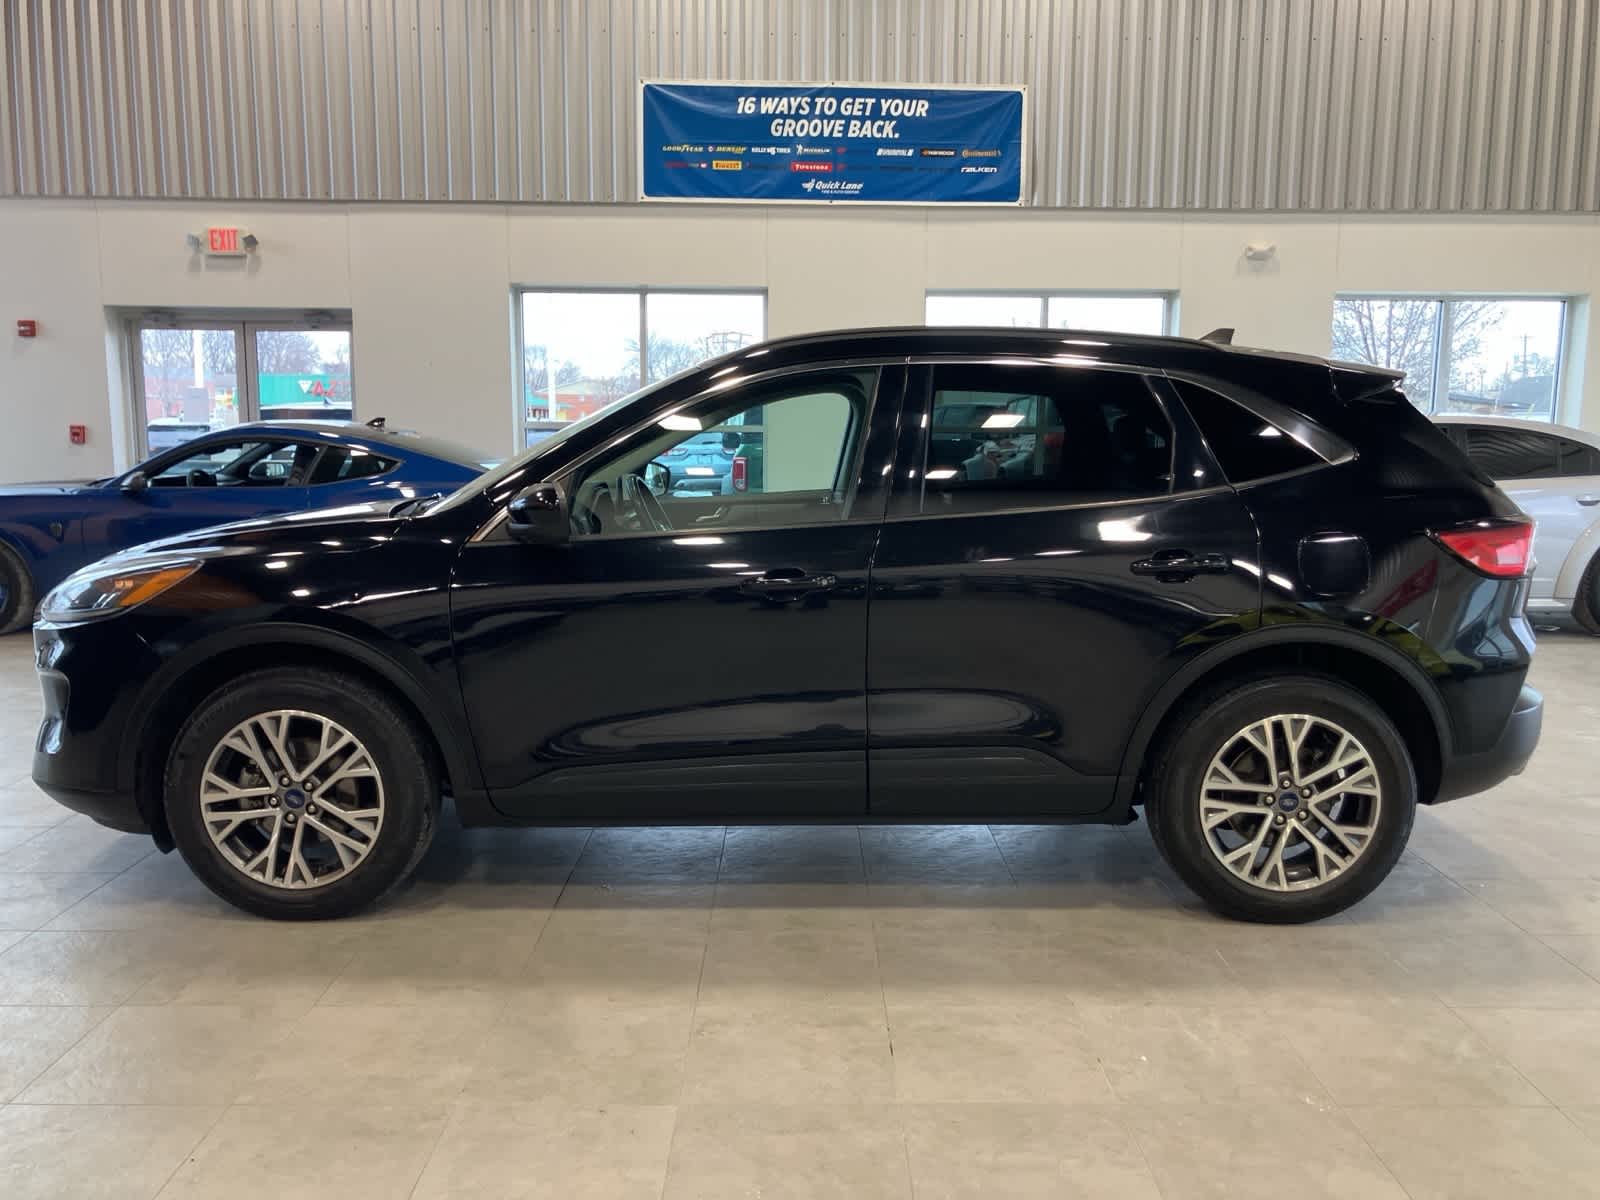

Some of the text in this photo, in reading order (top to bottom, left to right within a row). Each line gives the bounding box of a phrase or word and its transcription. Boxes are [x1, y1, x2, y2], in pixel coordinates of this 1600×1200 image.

[736, 96, 929, 117] 16 WAYS TO GET YOUR
[770, 118, 900, 138] GROOVE BACK.
[662, 144, 704, 153] GOODYEAR
[815, 180, 864, 190] Quick Lane
[208, 226, 239, 252] EXIT
